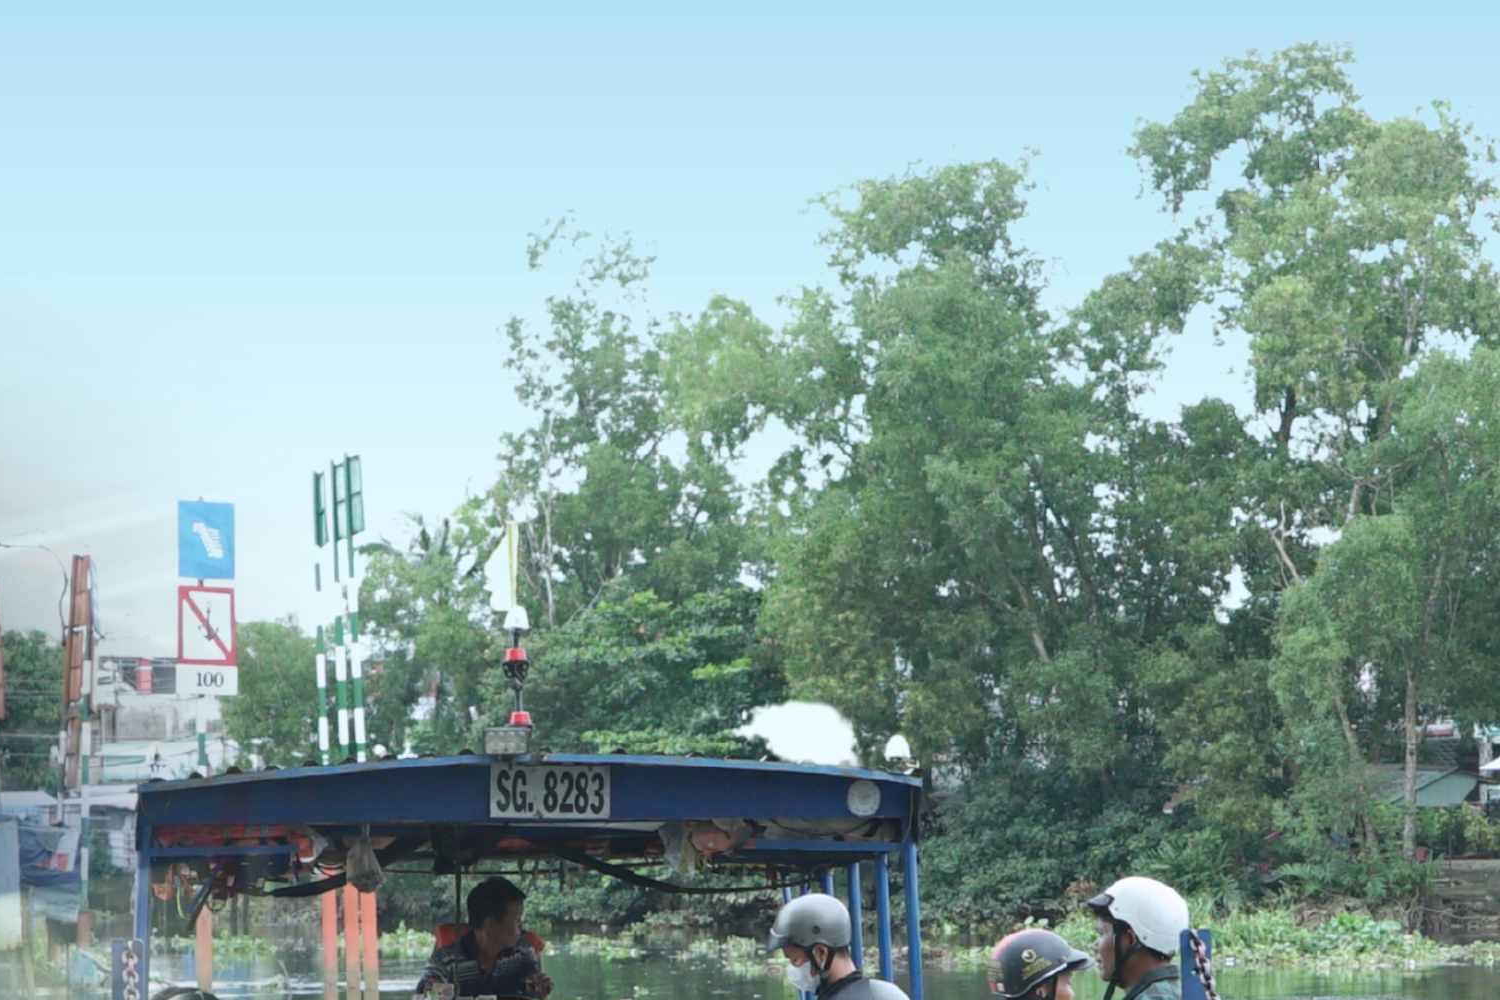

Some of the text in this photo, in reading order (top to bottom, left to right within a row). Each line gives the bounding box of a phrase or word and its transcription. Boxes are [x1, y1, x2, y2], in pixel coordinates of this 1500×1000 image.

[196, 671, 224, 688] 100
[495, 769, 605, 815] SG. 8283
